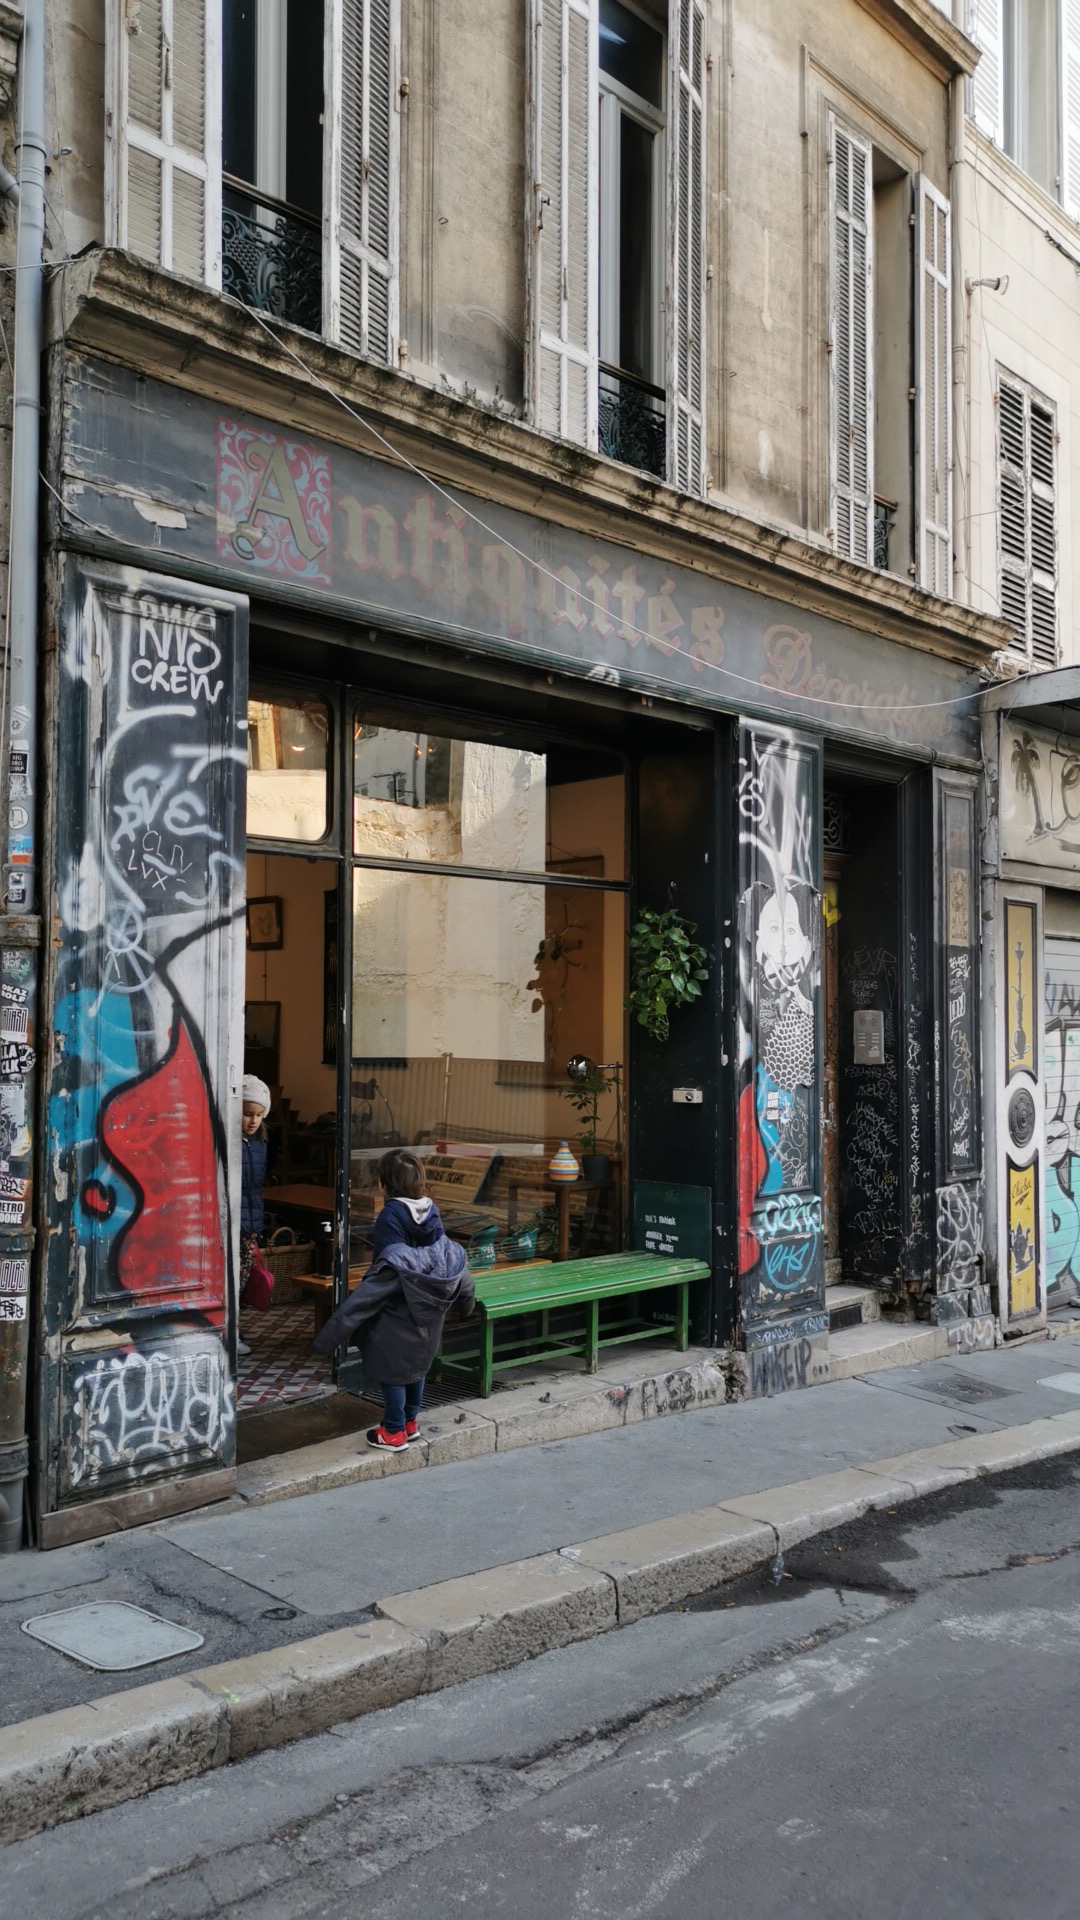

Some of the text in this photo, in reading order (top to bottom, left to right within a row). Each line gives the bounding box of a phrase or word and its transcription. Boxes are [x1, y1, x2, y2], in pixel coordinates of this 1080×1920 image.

[132, 659, 224, 704] CREW
[2, 984, 28, 997] OKAZ
[0, 1202, 23, 1213] ETRO
